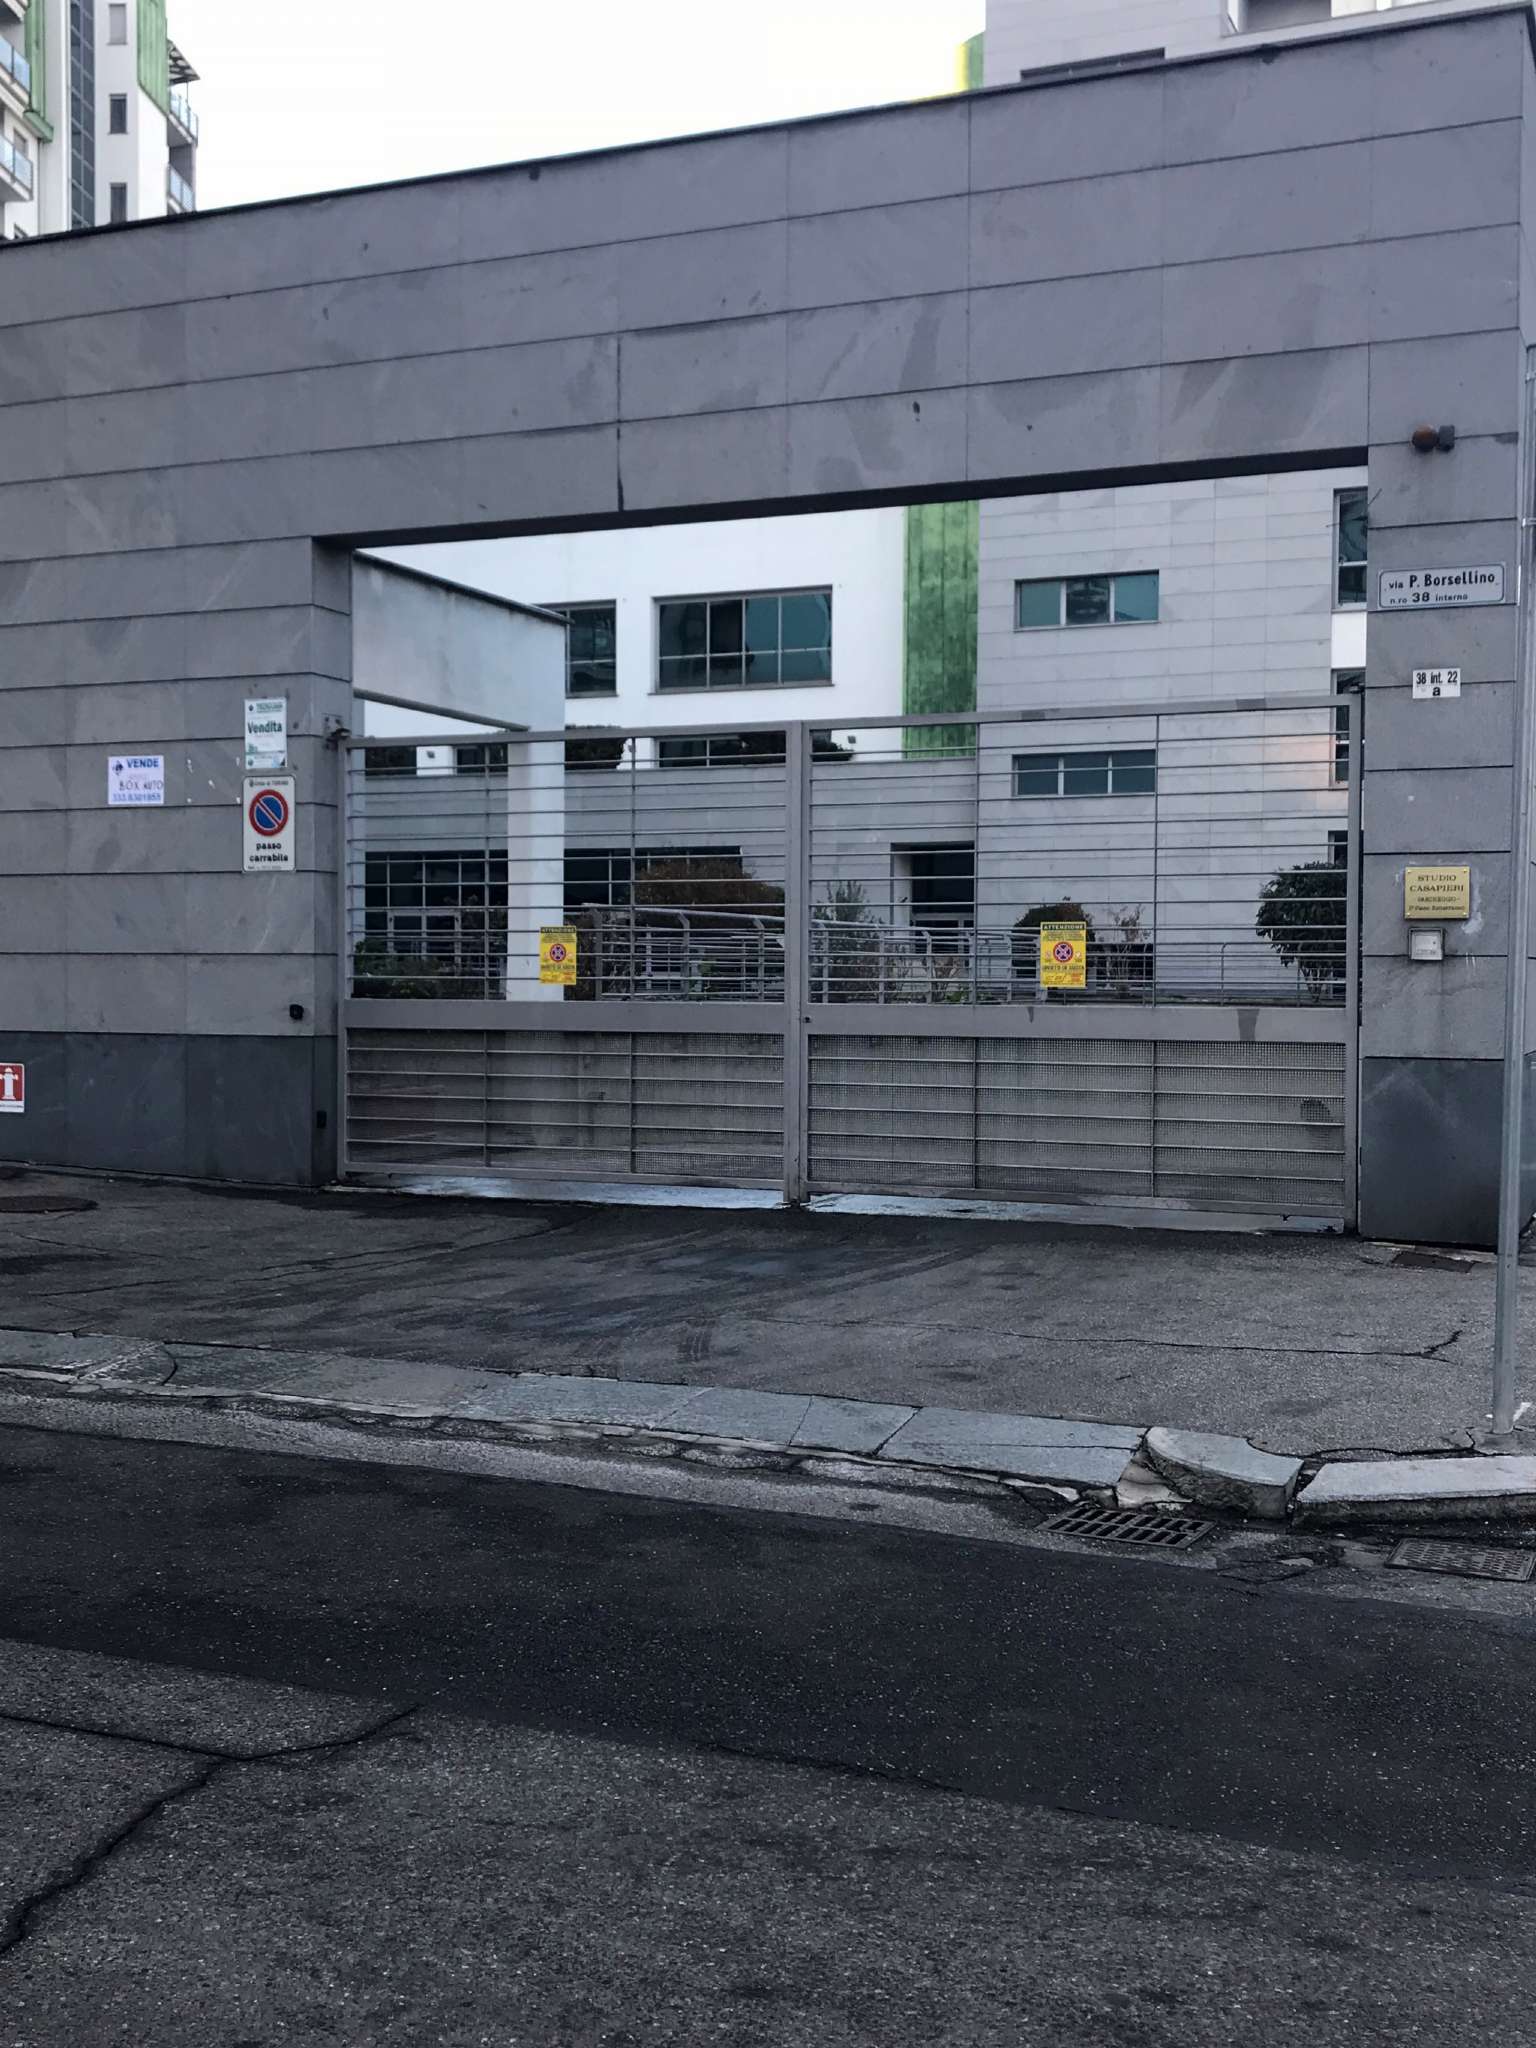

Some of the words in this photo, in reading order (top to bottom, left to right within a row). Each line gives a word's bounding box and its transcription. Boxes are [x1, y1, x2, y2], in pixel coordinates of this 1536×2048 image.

[1388, 580, 1404, 589] via
[1409, 574, 1421, 588] P.
[1424, 570, 1496, 587] Borsellino
[1411, 591, 1431, 603] 38
[1435, 593, 1468, 602] interno
[1416, 671, 1427, 684] 38
[1447, 670, 1458, 684] 22
[1432, 686, 1441, 696] a
[247, 720, 283, 734] Vendita
[127, 758, 160, 768] VENDE
[256, 842, 282, 851] passo
[249, 853, 289, 862] carrabile
[1417, 874, 1457, 882] STUDIO
